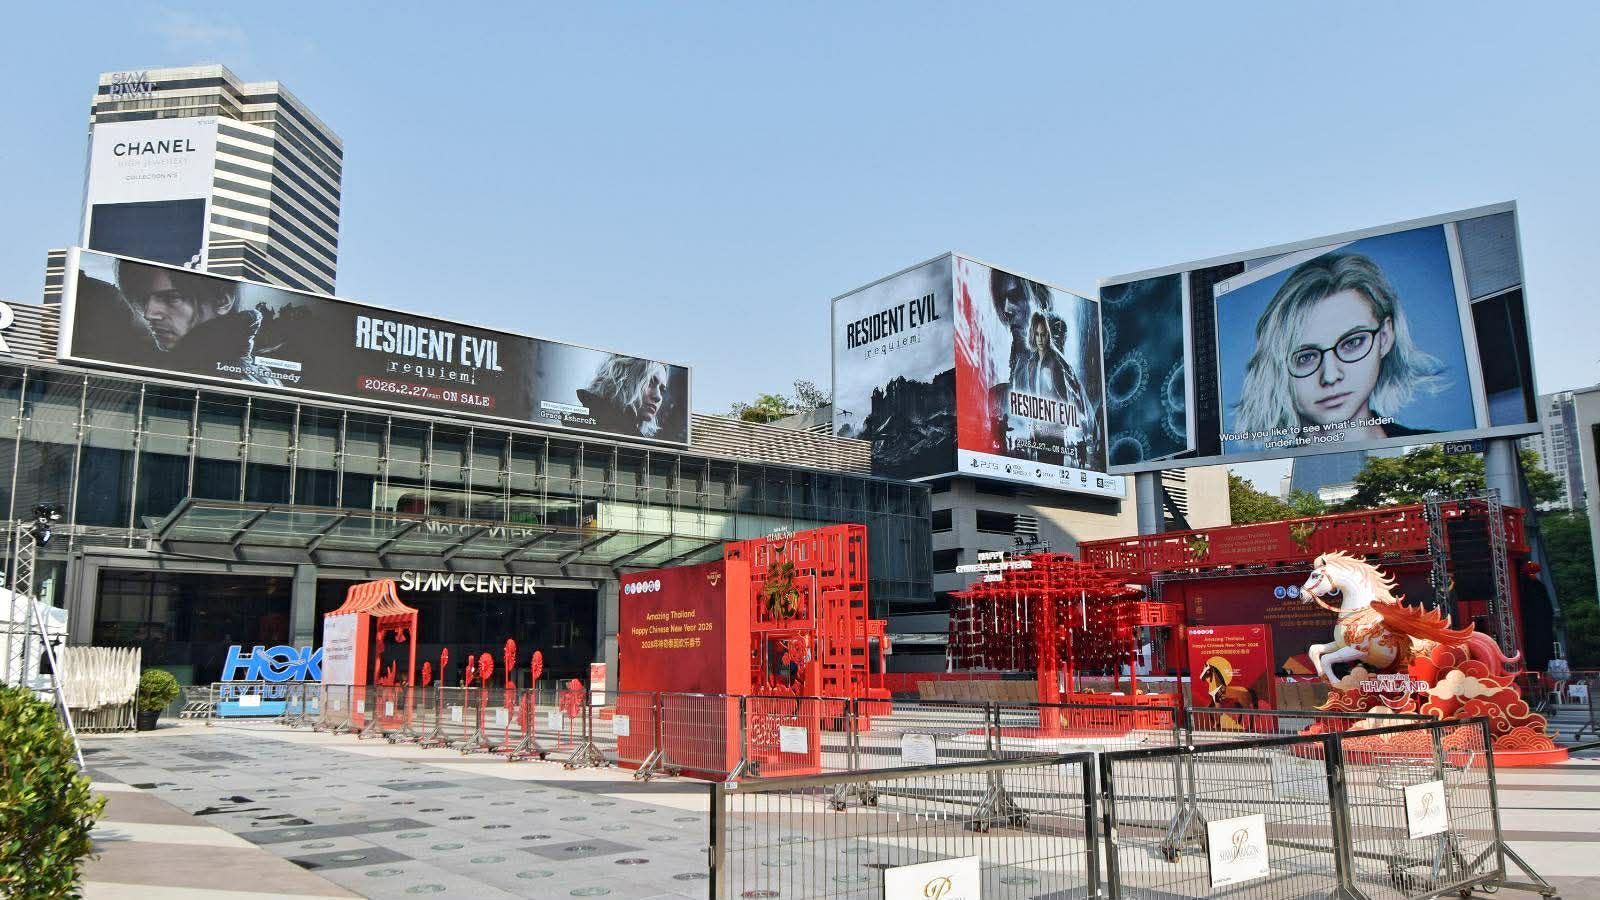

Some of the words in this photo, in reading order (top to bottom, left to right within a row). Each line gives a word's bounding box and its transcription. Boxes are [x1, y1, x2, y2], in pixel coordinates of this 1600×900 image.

[114, 138, 196, 157] CHANEL
[847, 304, 905, 350] RESIDENT
[909, 293, 942, 329] EVIL
[356, 315, 455, 363] RESIDENT
[461, 335, 503, 371] EVIL
[216, 362, 242, 373] Leon
[259, 369, 301, 383] Kennedy
[365, 379, 428, 398] 2026.2.27
[442, 390, 458, 402] ON
[461, 393, 490, 407] SALE
[541, 410, 561, 420] Grace
[565, 414, 597, 425] Ashcroft
[1010, 391, 1057, 423] RESIDENT
[1060, 402, 1080, 428] EVIL
[1219, 432, 1249, 442] Would
[1251, 431, 1270, 442] you
[1271, 427, 1288, 437] like
[1290, 425, 1300, 434] to
[1303, 425, 1320, 433] see
[1322, 421, 1356, 431] what's
[1358, 416, 1394, 428] hidden
[1264, 438, 1292, 449] under
[1295, 436, 1311, 446] the
[1313, 433, 1345, 444] hood?
[1061, 447, 1076, 456] SALE
[981, 461, 999, 470] PS5
[400, 571, 455, 592] SIAM
[460, 573, 536, 595] CENTER
[647, 613, 670, 622] Amazing
[671, 610, 696, 619] Thailand
[632, 627, 648, 636] Happy
[649, 625, 670, 634] Chinese
[671, 624, 683, 633] New
[684, 622, 697, 632] Year
[698, 622, 713, 631] 2026
[222, 645, 323, 682] HOK
[1360, 681, 1429, 692] THAILAND
